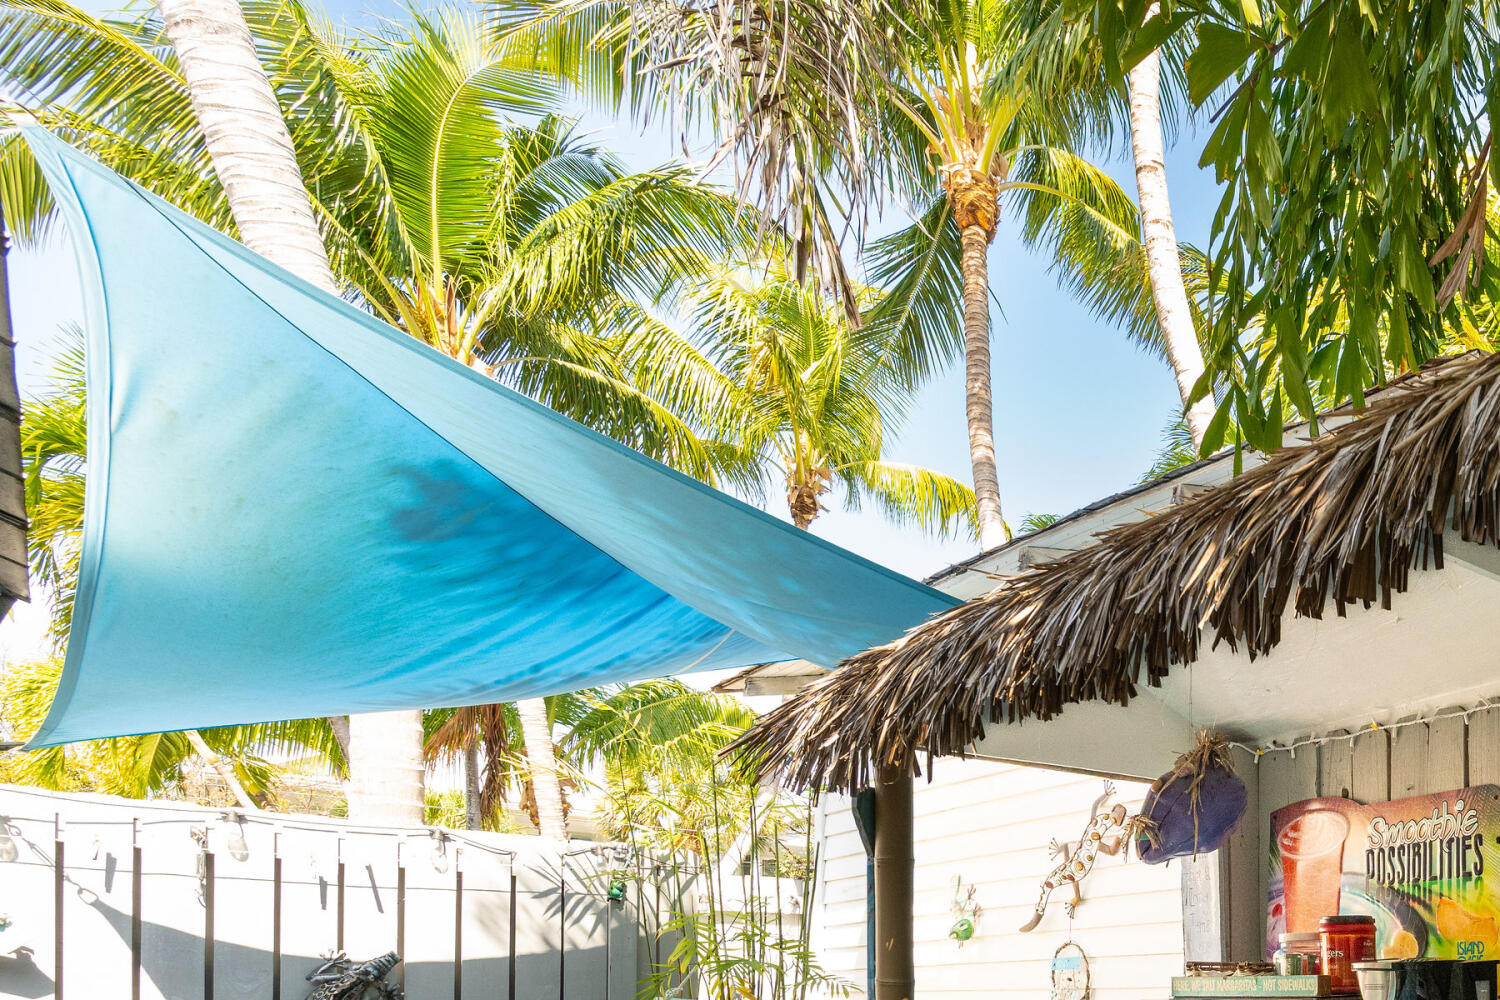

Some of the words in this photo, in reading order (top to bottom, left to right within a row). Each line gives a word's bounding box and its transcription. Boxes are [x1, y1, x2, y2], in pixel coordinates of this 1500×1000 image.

[1367, 800, 1478, 851] Smoothie
[1366, 834, 1484, 887] POSSIBILITIES
[1457, 941, 1485, 955] ISLAND
[1217, 979, 1257, 991] MARGARITAS
[1278, 978, 1315, 991] SIDEWALKS
